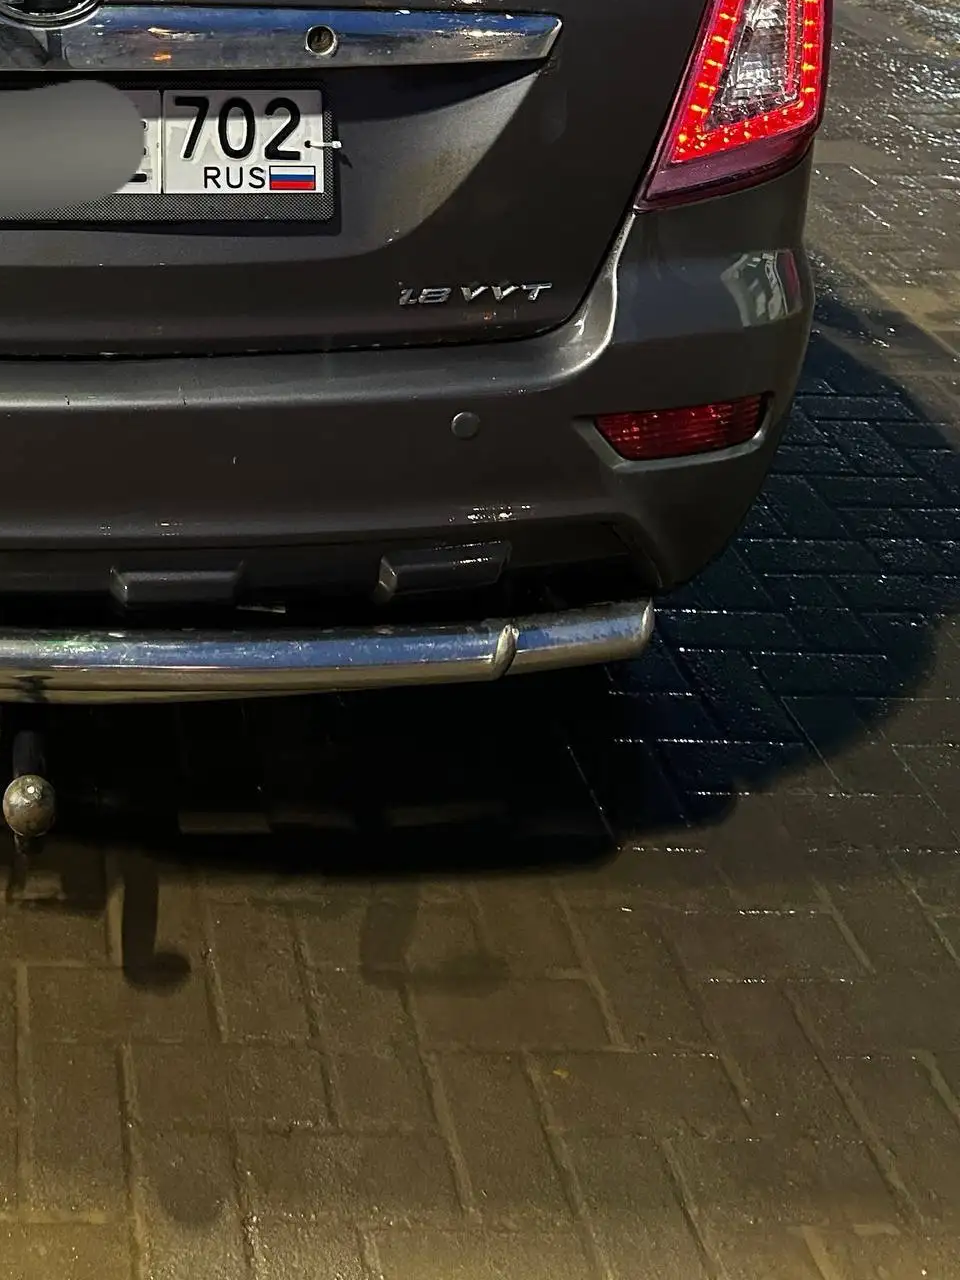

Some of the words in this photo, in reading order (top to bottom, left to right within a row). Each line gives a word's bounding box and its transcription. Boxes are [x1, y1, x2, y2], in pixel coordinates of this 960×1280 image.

[174, 96, 302, 161] 702
[203, 166, 266, 189] RUS
[460, 282, 553, 302] VVT
